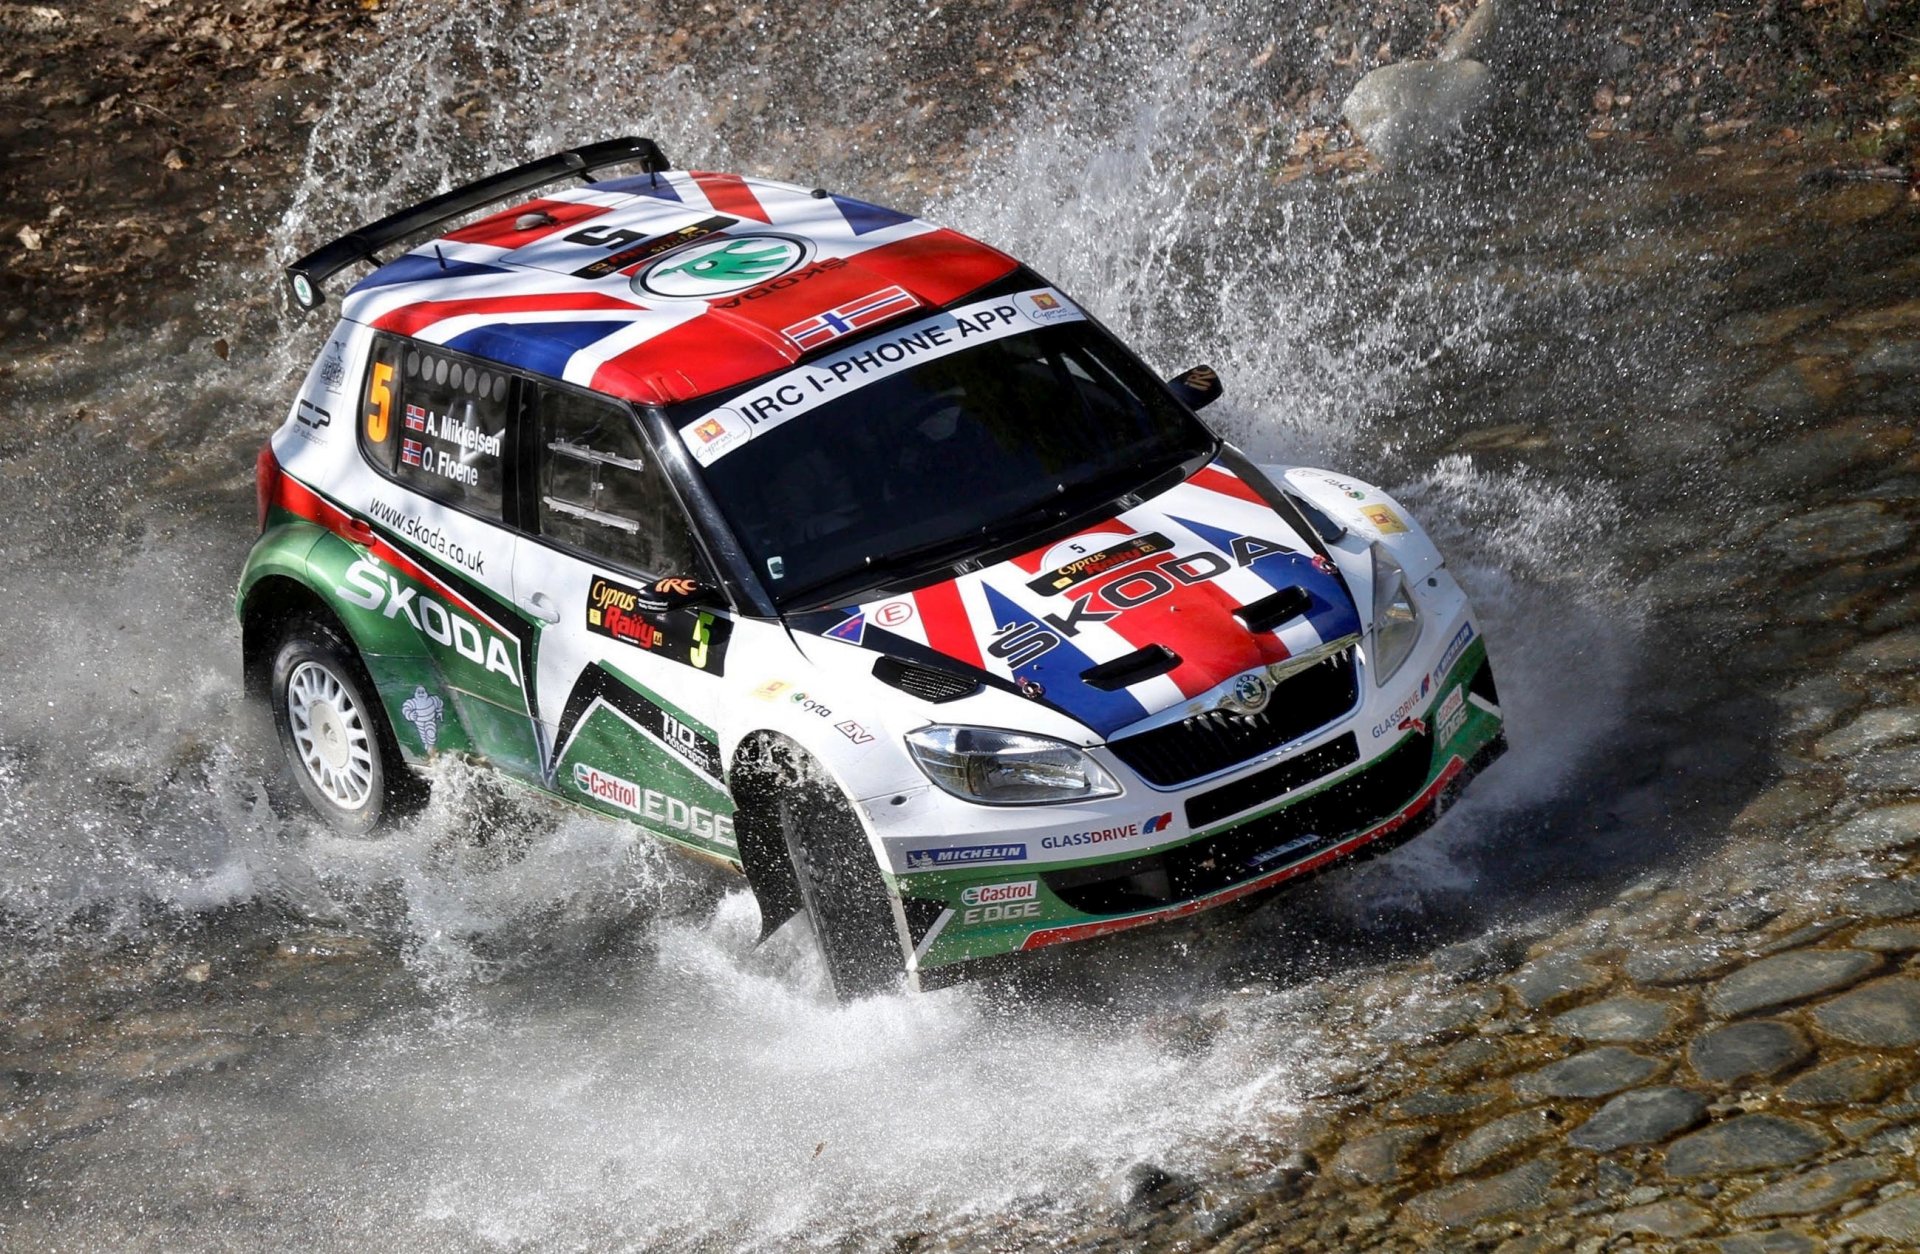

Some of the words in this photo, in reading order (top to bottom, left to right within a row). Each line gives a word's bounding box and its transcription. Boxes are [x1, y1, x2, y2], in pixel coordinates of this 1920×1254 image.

[563, 225, 651, 250] 5
[740, 384, 804, 425] IRC
[807, 324, 952, 393] I-PHONE
[957, 304, 1017, 338] APP
[367, 362, 393, 443] 5
[425, 411, 438, 437] A.
[441, 415, 500, 457] Mikkelsen
[422, 447, 435, 473] O.
[437, 450, 479, 486] Floene
[370, 498, 485, 576] www.skoda.co.uk
[1069, 543, 1086, 554] 5
[1058, 552, 1106, 575] Cyprus
[592, 580, 637, 611] Cyprus
[655, 578, 697, 596] IRC
[987, 535, 1299, 671] ŠKODA
[335, 552, 521, 688] ŠKODA
[604, 606, 656, 649] Rally
[884, 604, 905, 622] E
[690, 611, 715, 668] 5
[803, 699, 832, 718] cyta
[1372, 690, 1420, 738] GLASSDRIVE
[661, 710, 695, 749] 110
[590, 771, 637, 808] Castrol
[641, 788, 737, 848] EDGE
[1041, 823, 1138, 849] GLASSDRIVE
[936, 847, 1021, 862] MICHELIN
[979, 883, 1033, 902] Castrol
[963, 902, 1041, 925] EDGE
